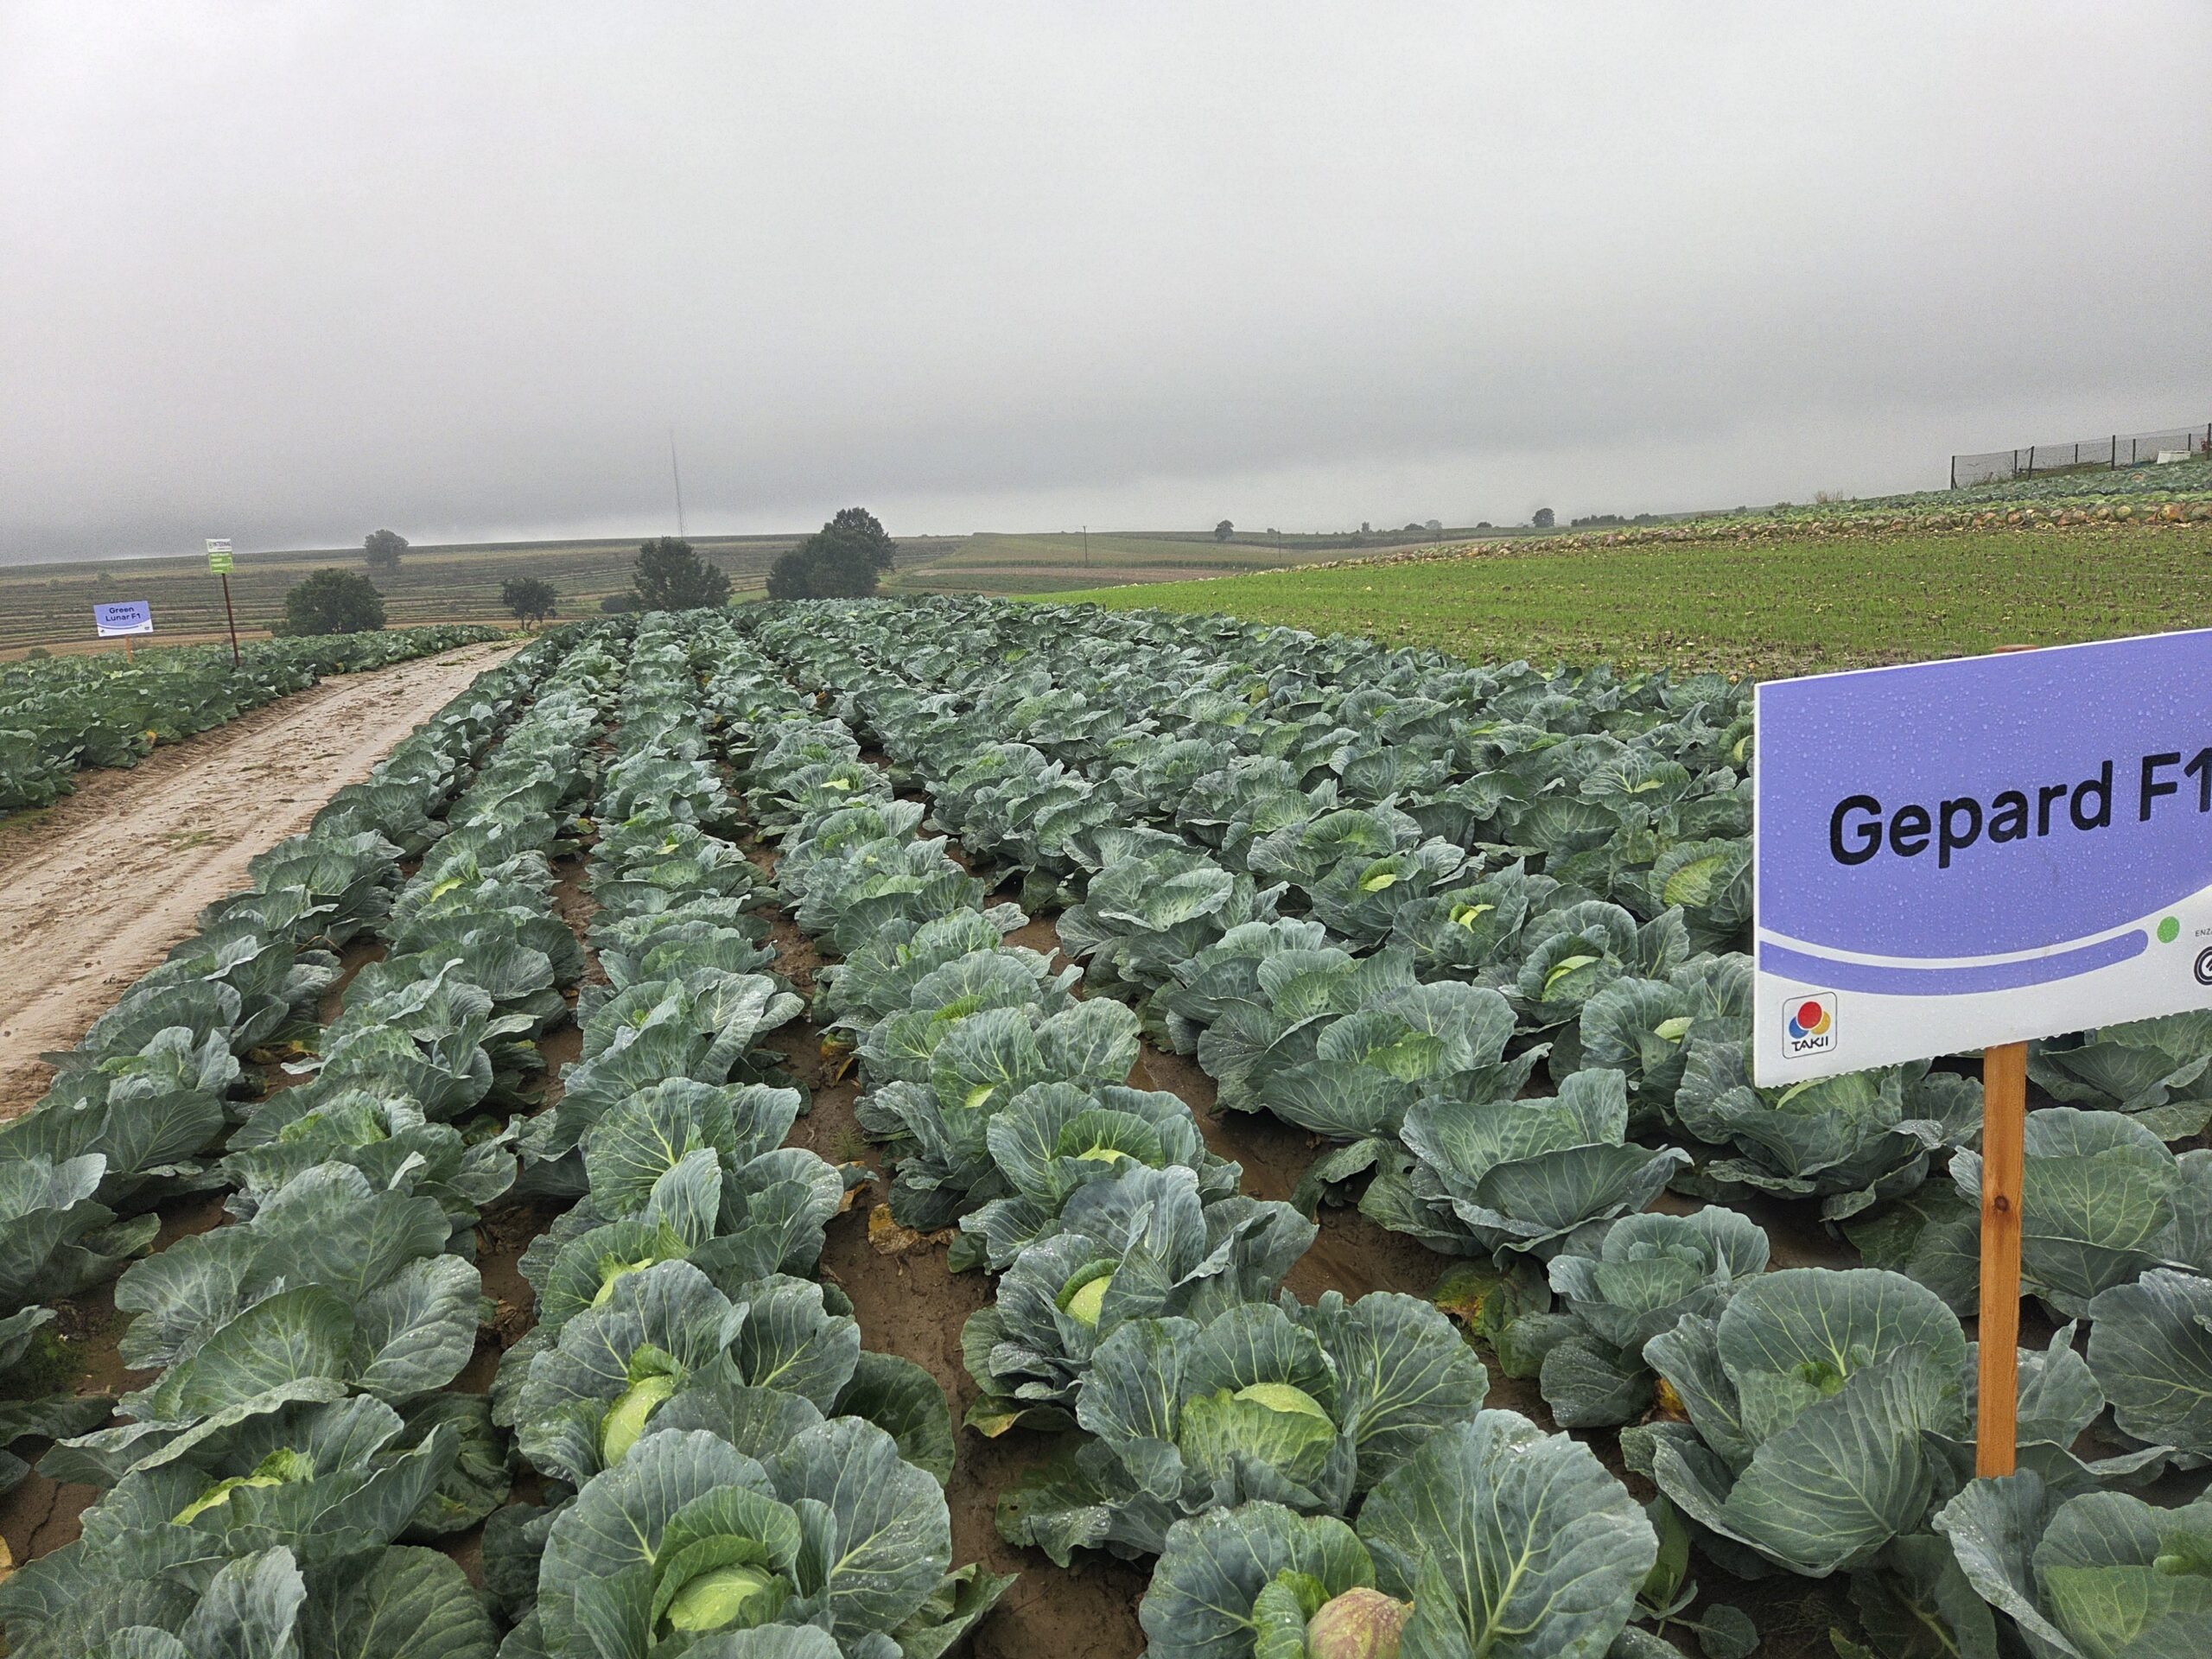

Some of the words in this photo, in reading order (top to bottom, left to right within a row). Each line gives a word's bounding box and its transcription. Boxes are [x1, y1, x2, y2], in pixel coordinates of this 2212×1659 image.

[1829, 760, 2113, 869] Gepard
[2139, 747, 2212, 822] F1
[2195, 927, 2212, 938] ENZ
[1791, 1036, 1828, 1052] TAKII
